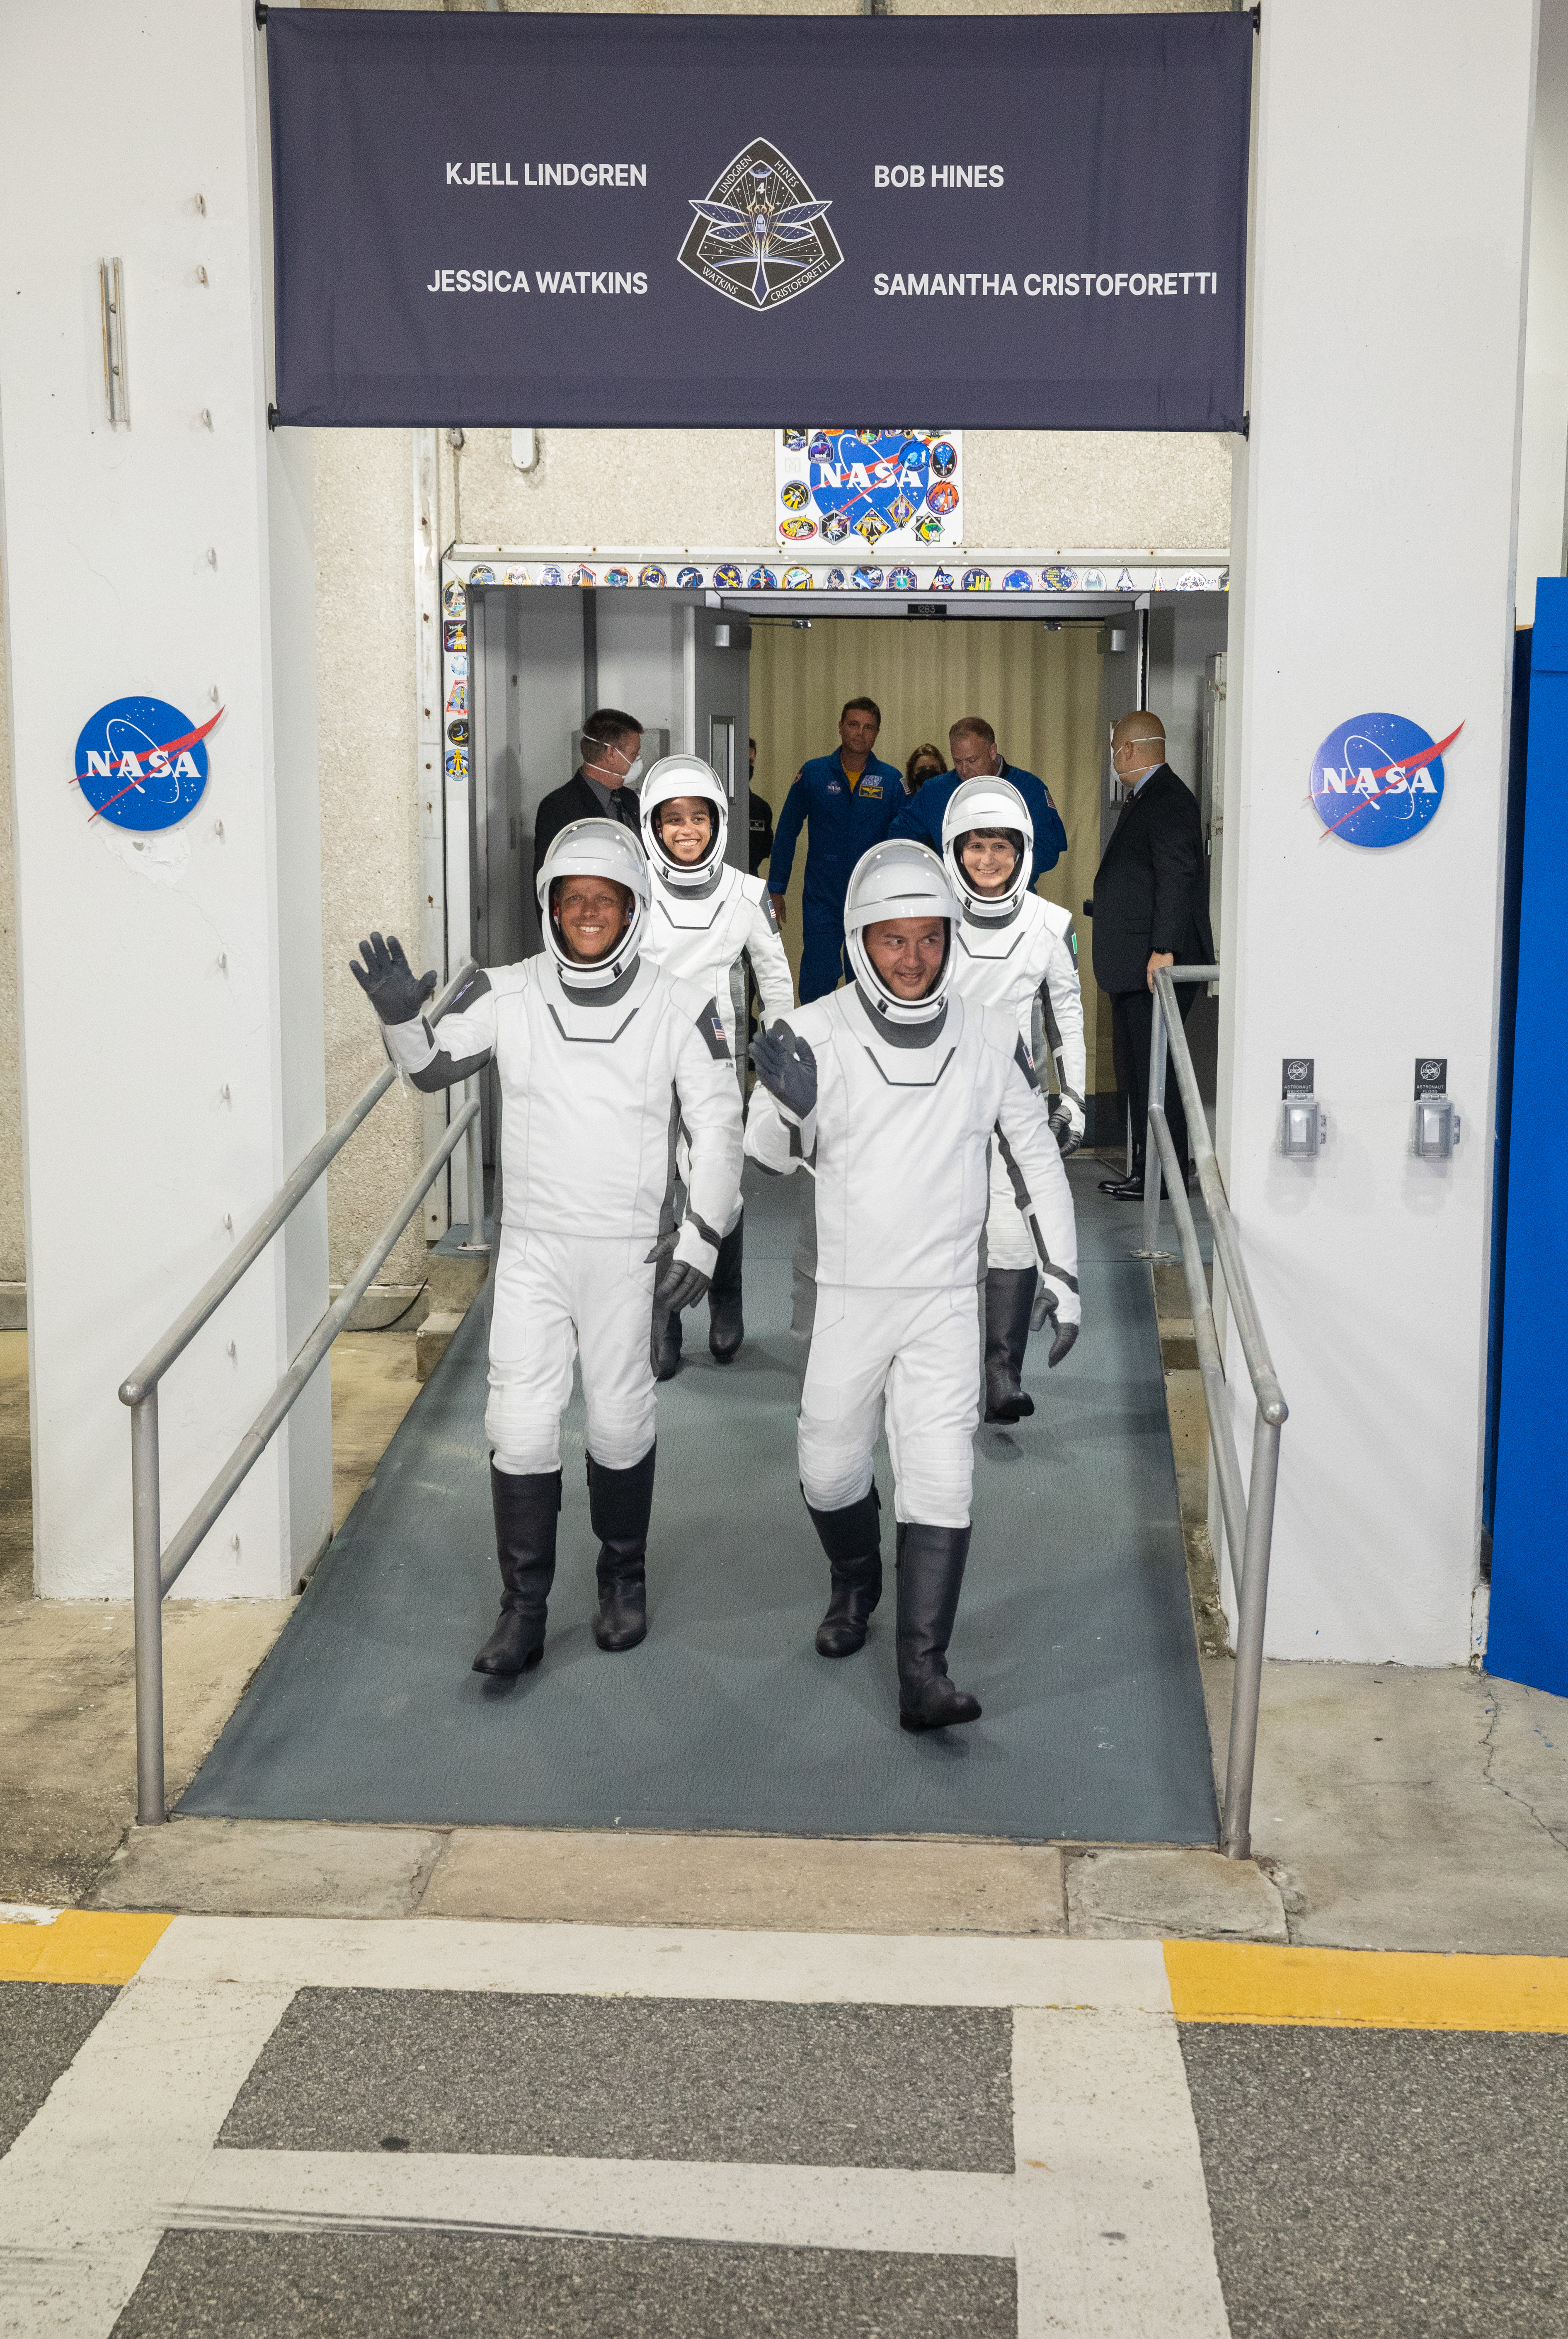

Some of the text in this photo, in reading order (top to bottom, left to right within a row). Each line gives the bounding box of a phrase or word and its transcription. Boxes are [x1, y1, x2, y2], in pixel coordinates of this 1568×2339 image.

[446, 162, 647, 187] KJELL LINDGREN
[718, 155, 753, 194] LINDGREN
[774, 160, 799, 188] HINES
[875, 165, 1005, 188] BOB HINES
[756, 182, 765, 194] 4
[427, 269, 648, 295] JESSICA WATKINS
[702, 266, 739, 295] WATKINS
[770, 259, 831, 302] CRISTOFORETTI
[873, 272, 1217, 297] SAMANTHA CRISTOFORETTI
[819, 463, 923, 488] NASA
[85, 750, 201, 778] NASA
[1321, 767, 1438, 794] NASA
